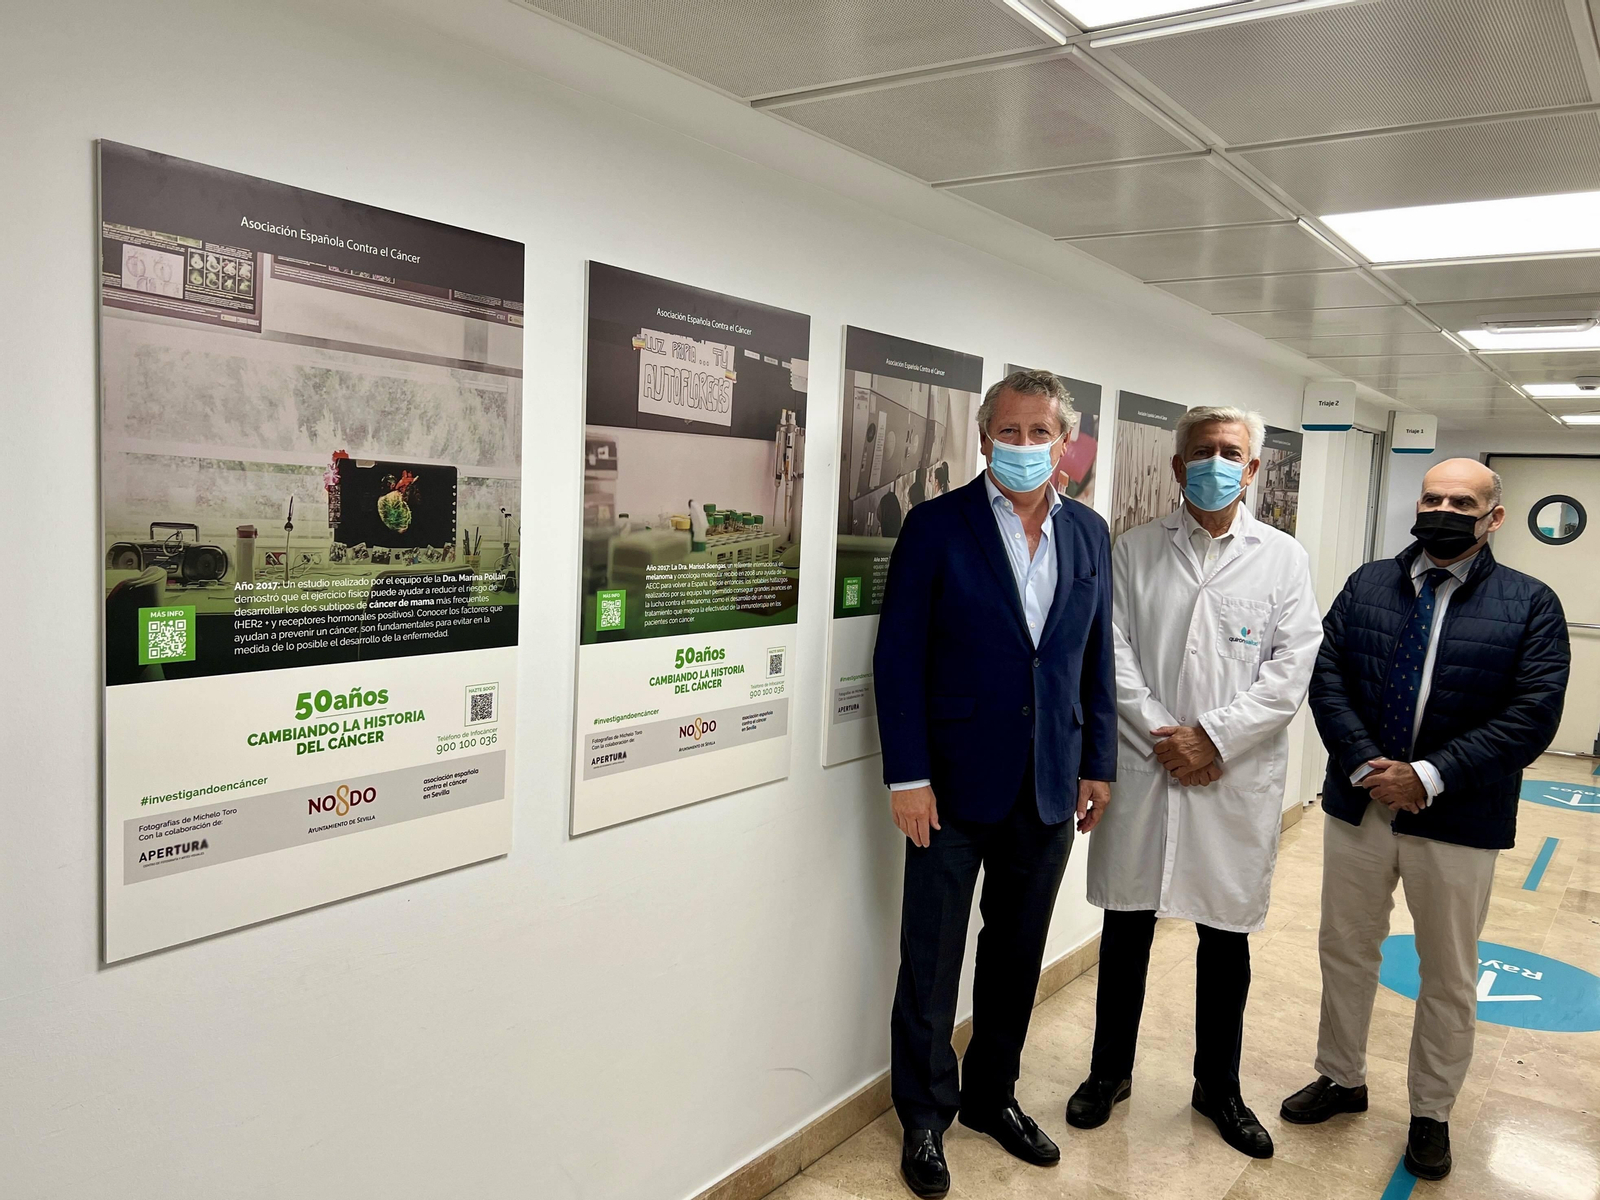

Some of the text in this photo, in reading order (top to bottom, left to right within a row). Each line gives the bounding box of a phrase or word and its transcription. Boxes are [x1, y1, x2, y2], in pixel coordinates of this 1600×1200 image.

[241, 215, 420, 264] Asociación Española Contra el Cáncer
[657, 308, 686, 322] Asociación
[687, 314, 710, 326] Española
[712, 320, 728, 331] Contra
[735, 325, 752, 336] Cáncer
[644, 334, 666, 355] LUZ
[644, 364, 729, 413] AUTOFLORECES
[235, 582, 253, 591] Año
[256, 582, 280, 590] 2017:
[298, 579, 330, 588] estudio
[332, 578, 369, 587] realizado
[371, 579, 384, 588] por
[395, 576, 421, 586] equipo
[235, 593, 279, 604] demostró
[282, 594, 298, 603] que
[301, 592, 309, 600] el
[311, 591, 346, 602] ejercicio
[371, 589, 396, 599] puede
[398, 588, 424, 597] ayudar
[432, 586, 458, 594] reducir
[466, 585, 487, 593] riesgo
[235, 606, 283, 616] desarrollar
[301, 605, 317, 613] dos
[319, 603, 354, 613] subtipos
[369, 600, 396, 608] cáncer
[453, 595, 489, 604] frecuentes
[234, 619, 262, 630] (HER2
[271, 620, 276, 629] y
[279, 618, 325, 627] receptores
[328, 613, 376, 623] hormonales
[378, 610, 415, 622] positivos).
[234, 632, 269, 644] ayudan
[279, 628, 314, 641] prevenir
[378, 620, 434, 631] fundamentales
[436, 620, 452, 628] para
[453, 617, 472, 625] evitar
[235, 644, 270, 655] medida
[272, 643, 284, 652] de
[286, 642, 295, 651] lo
[297, 639, 328, 651] posible
[330, 638, 338, 647] el
[340, 635, 380, 646] desarrollo
[403, 630, 449, 640] enfermedad.
[675, 646, 725, 669] 50años
[650, 665, 745, 686] CAMBIANDO LA HISTORIA
[675, 679, 722, 694] DEL CÁNCER
[750, 690, 761, 700] 900
[295, 687, 389, 720] 50años
[594, 709, 659, 725] #investigandoencáncer
[247, 710, 425, 746] CAMBIANDO LA HISTORIA
[297, 730, 384, 755] DEL CÁNCER
[436, 733, 497, 755] 900 100 036
[591, 751, 627, 765] APERTURA
[424, 768, 479, 785] asociación española
[141, 776, 268, 806] #investigandoencáncer
[432, 789, 450, 798] Sevilla
[193, 811, 220, 822] Michelo
[165, 821, 210, 836] colaboración
[138, 838, 209, 863] APERTURA
[1478, 958, 1543, 980] Ray
